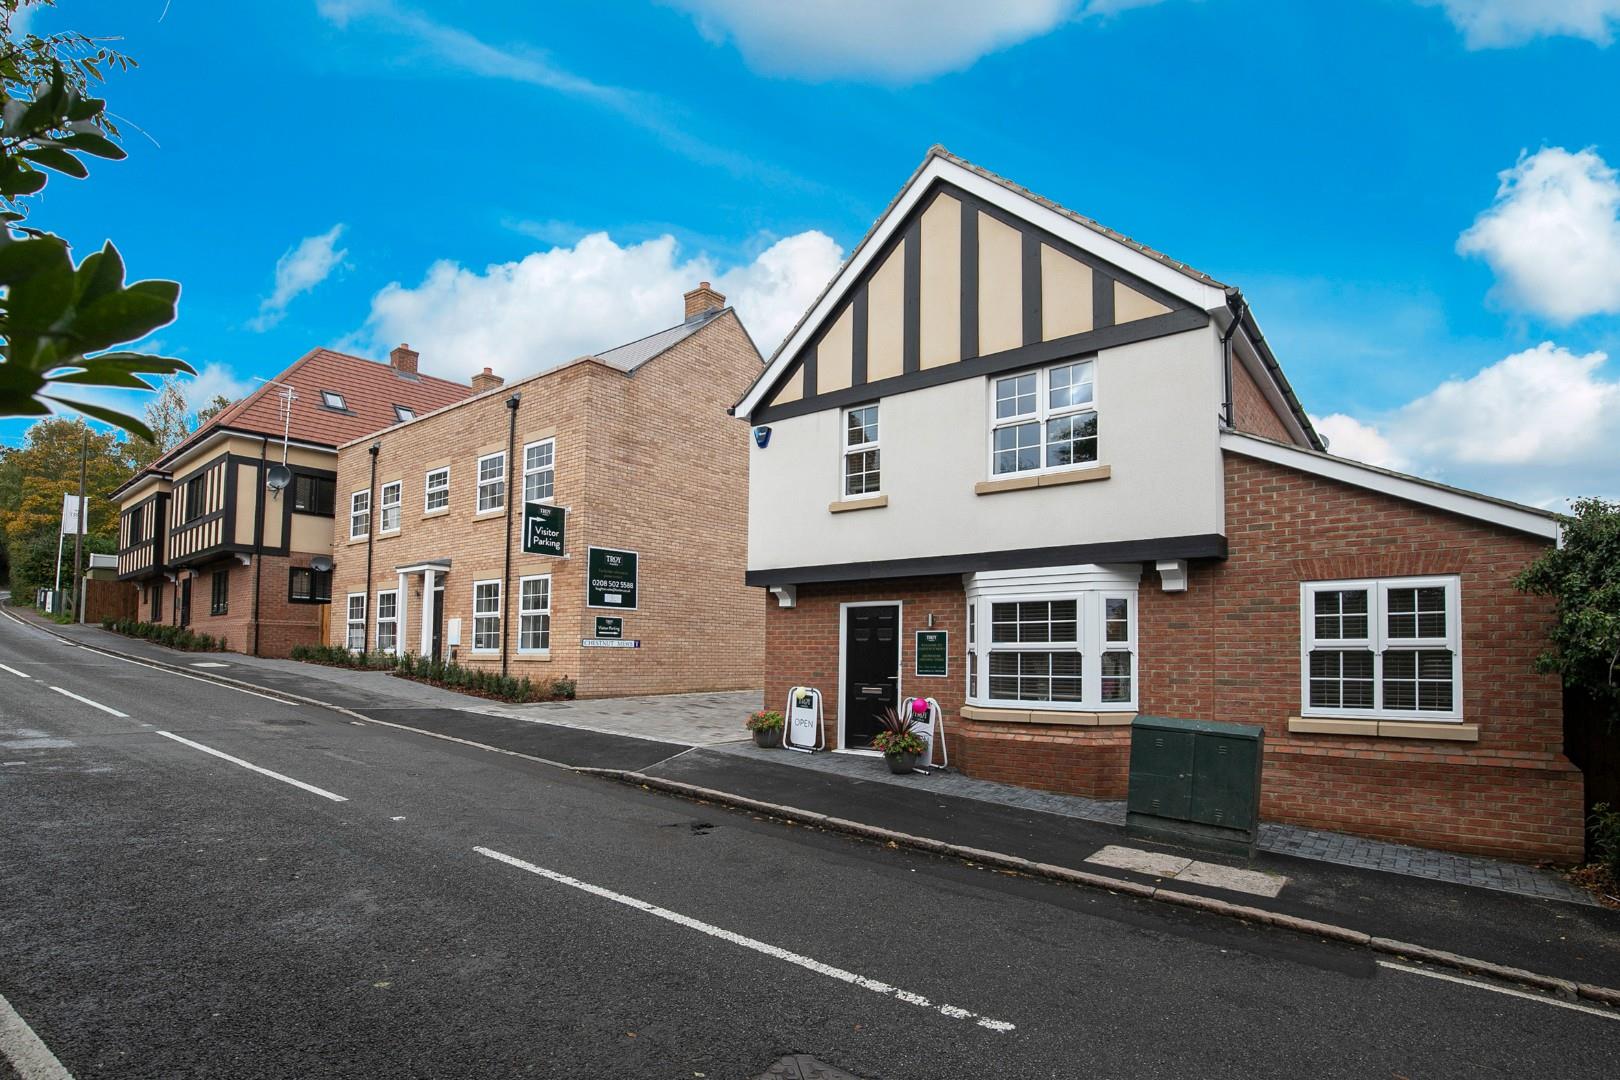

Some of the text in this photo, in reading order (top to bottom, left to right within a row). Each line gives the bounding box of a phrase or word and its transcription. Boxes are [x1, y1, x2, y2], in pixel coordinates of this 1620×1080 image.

[535, 525, 560, 537] Visitor
[533, 536, 561, 551] Parking
[592, 579, 608, 587] 0208
[608, 580, 620, 588] 502
[620, 581, 634, 589] 5588
[794, 718, 814, 728] OPEN
